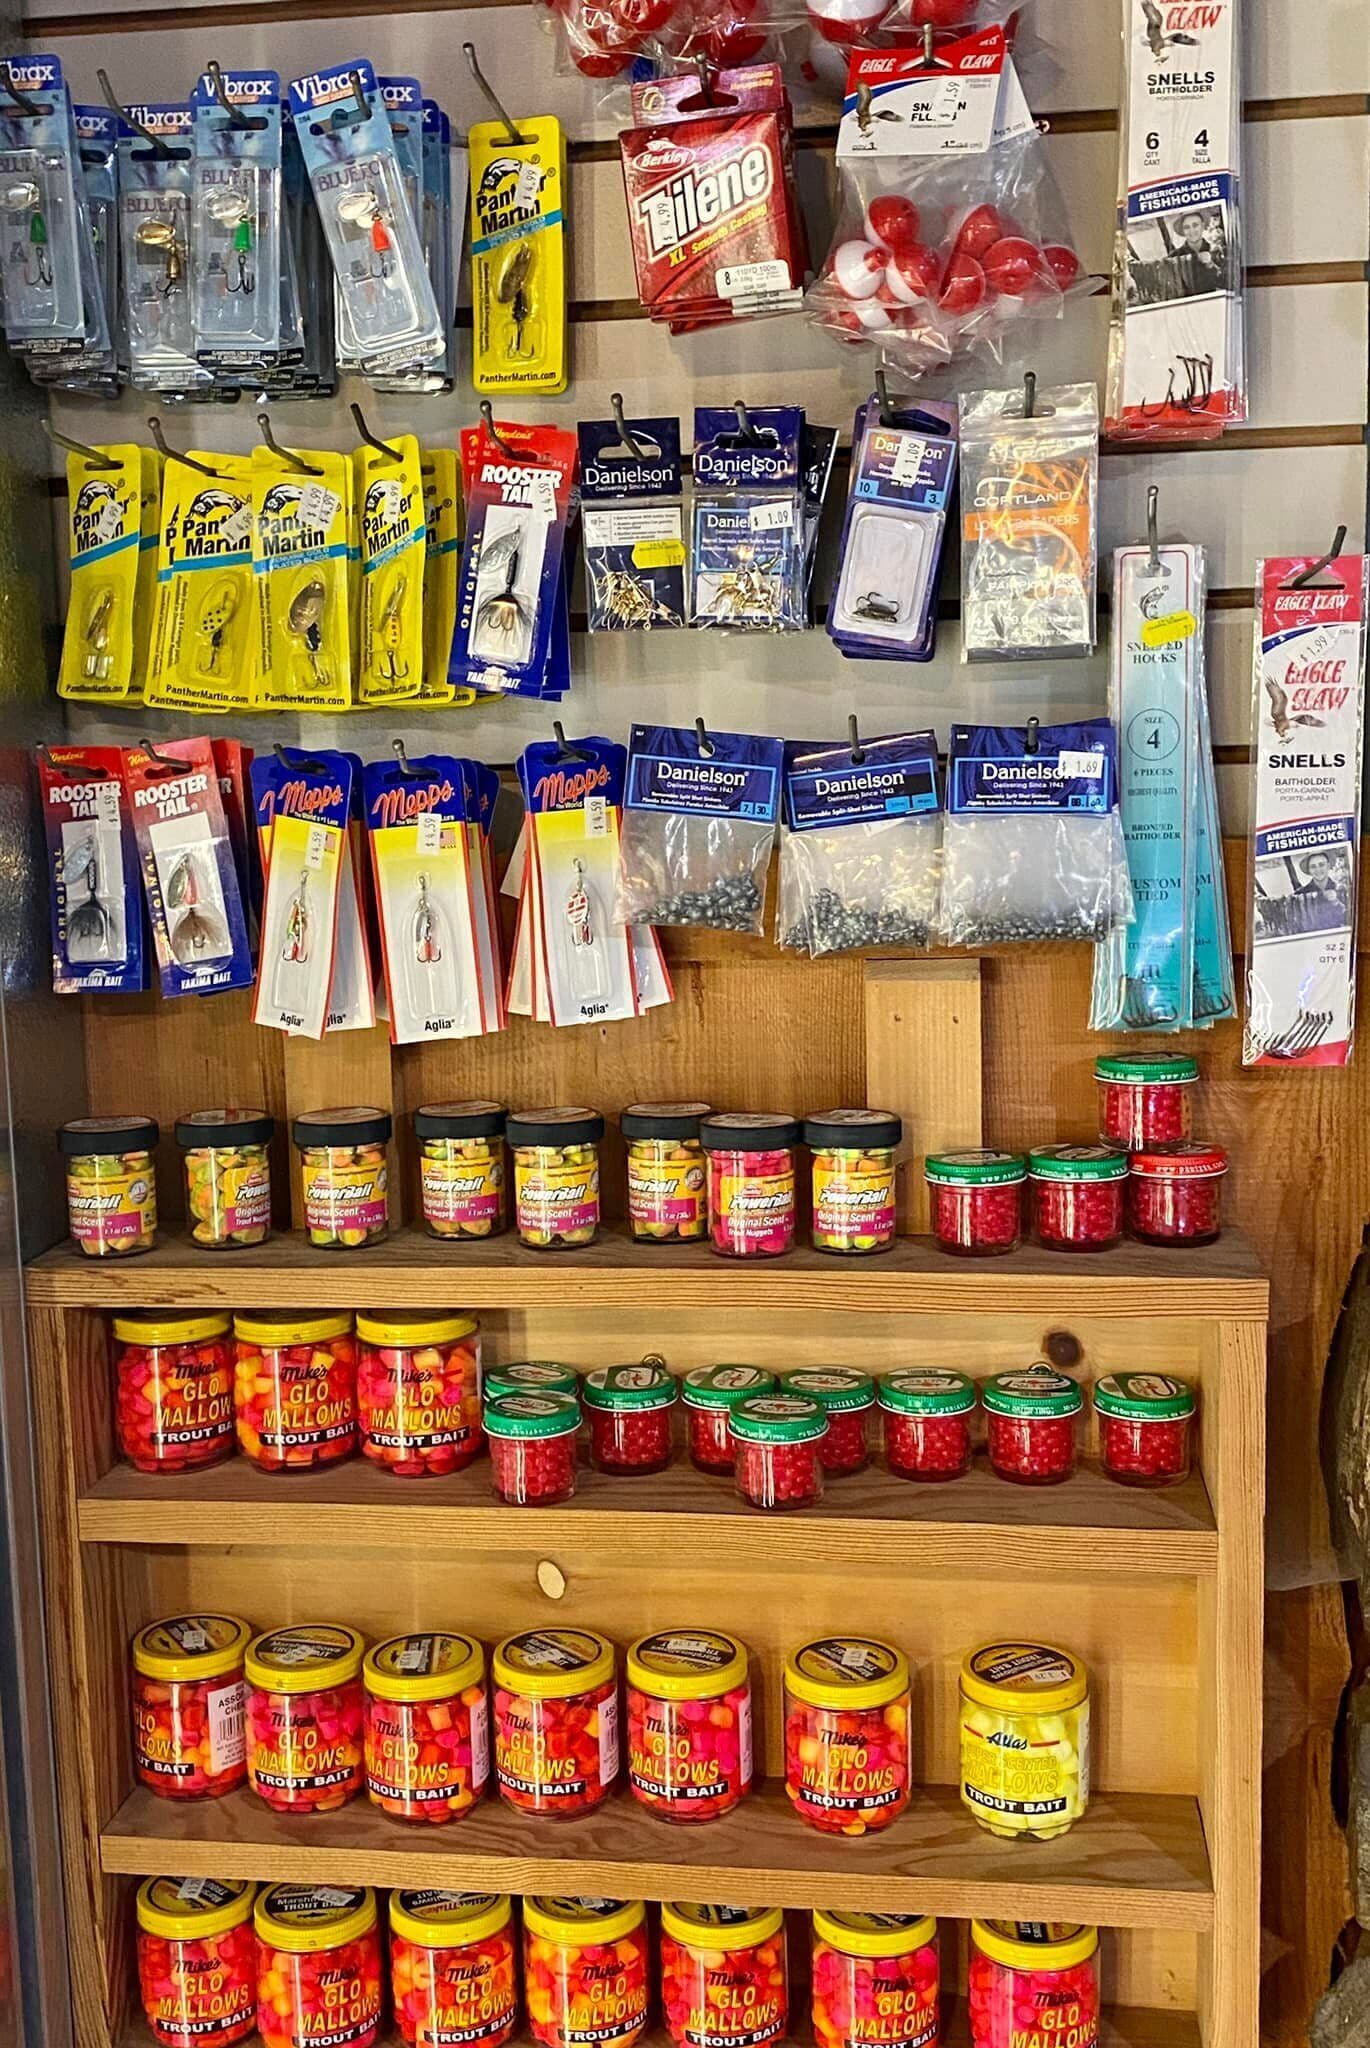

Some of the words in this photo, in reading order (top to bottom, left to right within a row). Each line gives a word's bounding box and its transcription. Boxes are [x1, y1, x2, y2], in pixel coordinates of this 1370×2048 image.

[1165, 6, 1222, 31] CLAW
[858, 58, 897, 74] EAGLE
[959, 54, 999, 69] CLAW
[1147, 71, 1215, 86] SNELLS
[1149, 86, 1213, 95] BAITHOLDER
[1146, 132, 1159, 150] 6
[1194, 129, 1209, 147] 4
[640, 149, 689, 166] Berkley
[1139, 179, 1218, 202] AMERICAN-MADE
[1140, 187, 1220, 212] FISHHOOKS
[669, 249, 687, 267] XL
[691, 227, 729, 254] Smooth
[730, 203, 768, 231] Casting
[724, 271, 731, 286] 8
[699, 454, 788, 473] Danielson
[481, 464, 562, 489] ROOSTER
[585, 465, 673, 485] Danielson
[929, 494, 936, 503] 3
[768, 510, 789, 525] 1.09
[262, 528, 325, 556] Martin
[1275, 594, 1311, 611] EAGLE
[166, 684, 249, 704] PantherMartin.com
[265, 693, 345, 705] PantherMartin.com
[1147, 728, 1161, 750] 4
[1076, 761, 1098, 773] 1.69
[1140, 768, 1174, 776] PIECES
[1268, 753, 1346, 769] SNELLS
[657, 762, 745, 786] Danielson
[815, 772, 905, 795] Danielson
[1275, 778, 1336, 786] BAITHOLDER
[49, 781, 121, 803] ROOSTER
[133, 774, 208, 808] ROOSTER
[278, 780, 341, 817] Mepps
[533, 763, 609, 812] Mepps
[156, 797, 190, 819] TAIL
[372, 779, 453, 828] Mepps
[757, 806, 766, 815] 30
[1266, 821, 1344, 842] AMERICAN-MADE
[1267, 830, 1345, 851] FISHHOOKS
[1339, 942, 1345, 951] 2
[1319, 955, 1337, 964] QTY
[1338, 954, 1345, 963] 6
[279, 1012, 301, 1027] Aglia
[580, 1003, 605, 1018] Aglia
[424, 1019, 452, 1032] Aglia
[334, 1207, 358, 1217] Scent
[547, 1209, 573, 1218] Scent
[764, 1215, 785, 1226] Scent
[850, 1211, 875, 1221] Scent
[280, 1364, 328, 1382] Mike's
[183, 1376, 219, 1402] GLO
[290, 1381, 329, 1404] GLO
[263, 1398, 351, 1428] MALLOWS
[156, 1428, 211, 1443] TROUT
[265, 1433, 320, 1445] TROUT
[326, 1422, 355, 1439] BAIT
[373, 1433, 425, 1447] TROUT
[431, 1429, 467, 1444] BAIT
[278, 1730, 317, 1750] GLO
[382, 1739, 419, 1761] GLO
[510, 1731, 545, 1754] GLO
[986, 1731, 1028, 1751] Atlas
[154, 1763, 189, 1774] BAIT
[828, 1748, 868, 1770] GLO
[257, 1772, 307, 1788] TROUT
[314, 1768, 351, 1786] BAIT
[368, 1778, 409, 1799] TROUT
[416, 1786, 454, 1800] BAIT
[497, 1769, 541, 1793] TROUT
[542, 1782, 581, 1796] BAIT
[634, 1776, 680, 1798] TROUT
[686, 1783, 725, 1798] BAIT
[802, 1766, 894, 1792] MALLOWS
[802, 1790, 858, 1808] TROUT
[863, 1790, 898, 1807] BAIT
[968, 1786, 1017, 1812] TROUT
[1024, 1799, 1063, 1814] BAIT
[447, 1962, 492, 1983] Mike's
[185, 1973, 224, 1995] GLO
[324, 1978, 361, 2008] GLO
[455, 1978, 492, 2004] GLO
[590, 1976, 627, 2003] GLO
[159, 1983, 249, 2019] MALLOWS
[716, 1987, 756, 2010] GLO
[877, 1992, 916, 2016] GLO
[161, 2019, 215, 2033] TROUT
[221, 2006, 253, 2029] BAIT
[428, 1991, 512, 2029] MALLOWS
[688, 1999, 779, 2033] MALLOWS
[1041, 2005, 1080, 2030] GLO
[430, 2028, 484, 2043] TROUT
[491, 2008, 516, 2032] BAIT
[566, 2026, 618, 2042] TROUT
[690, 2031, 748, 2048] TROUT
[752, 2019, 783, 2043] BAIT
[301, 2031, 355, 2048] TROUT
[913, 2026, 937, 2048] BAIT
